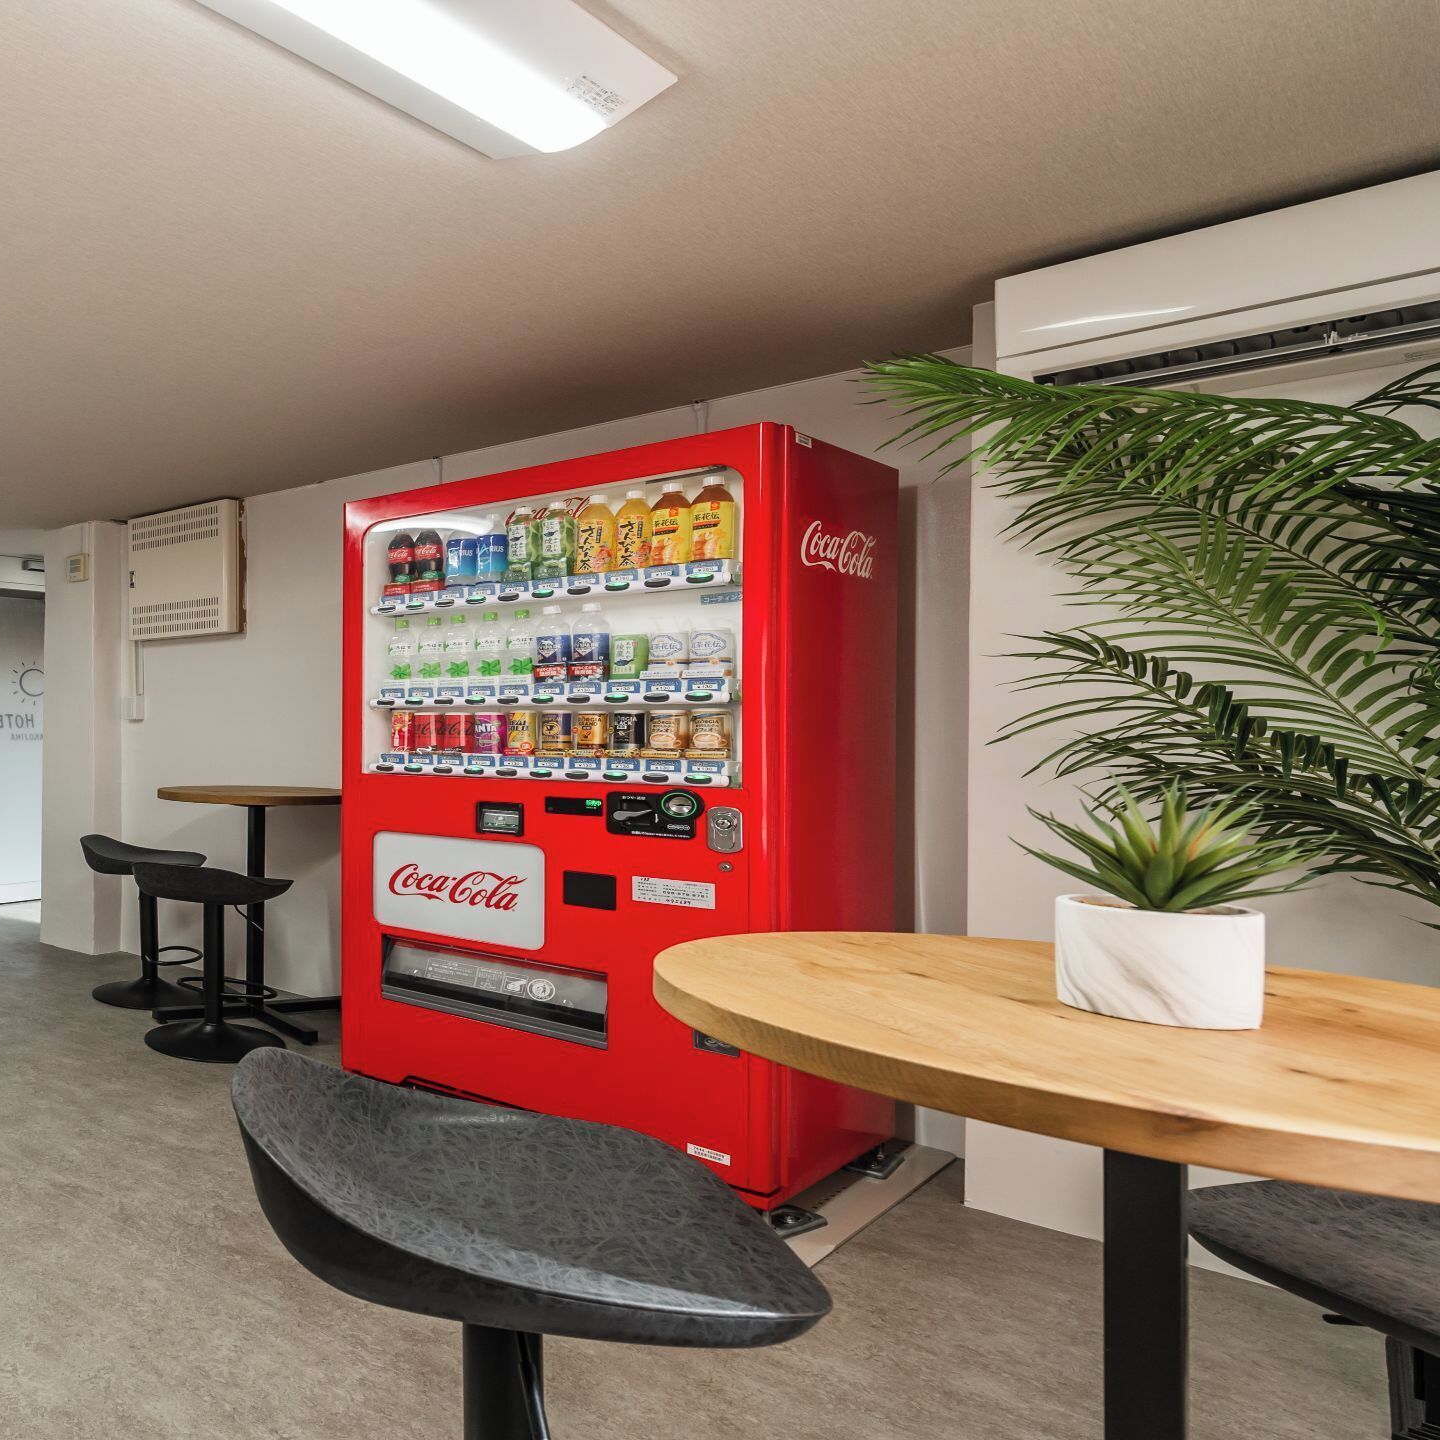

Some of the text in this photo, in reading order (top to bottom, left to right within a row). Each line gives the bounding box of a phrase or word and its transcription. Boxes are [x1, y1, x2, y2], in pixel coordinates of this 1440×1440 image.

[694, 512, 720, 521] 茶花伝
[654, 519, 679, 527] 茶花伝
[801, 520, 876, 578] Coca-Cola
[475, 723, 497, 733] ANTA
[388, 863, 528, 912] Coca-Cola
